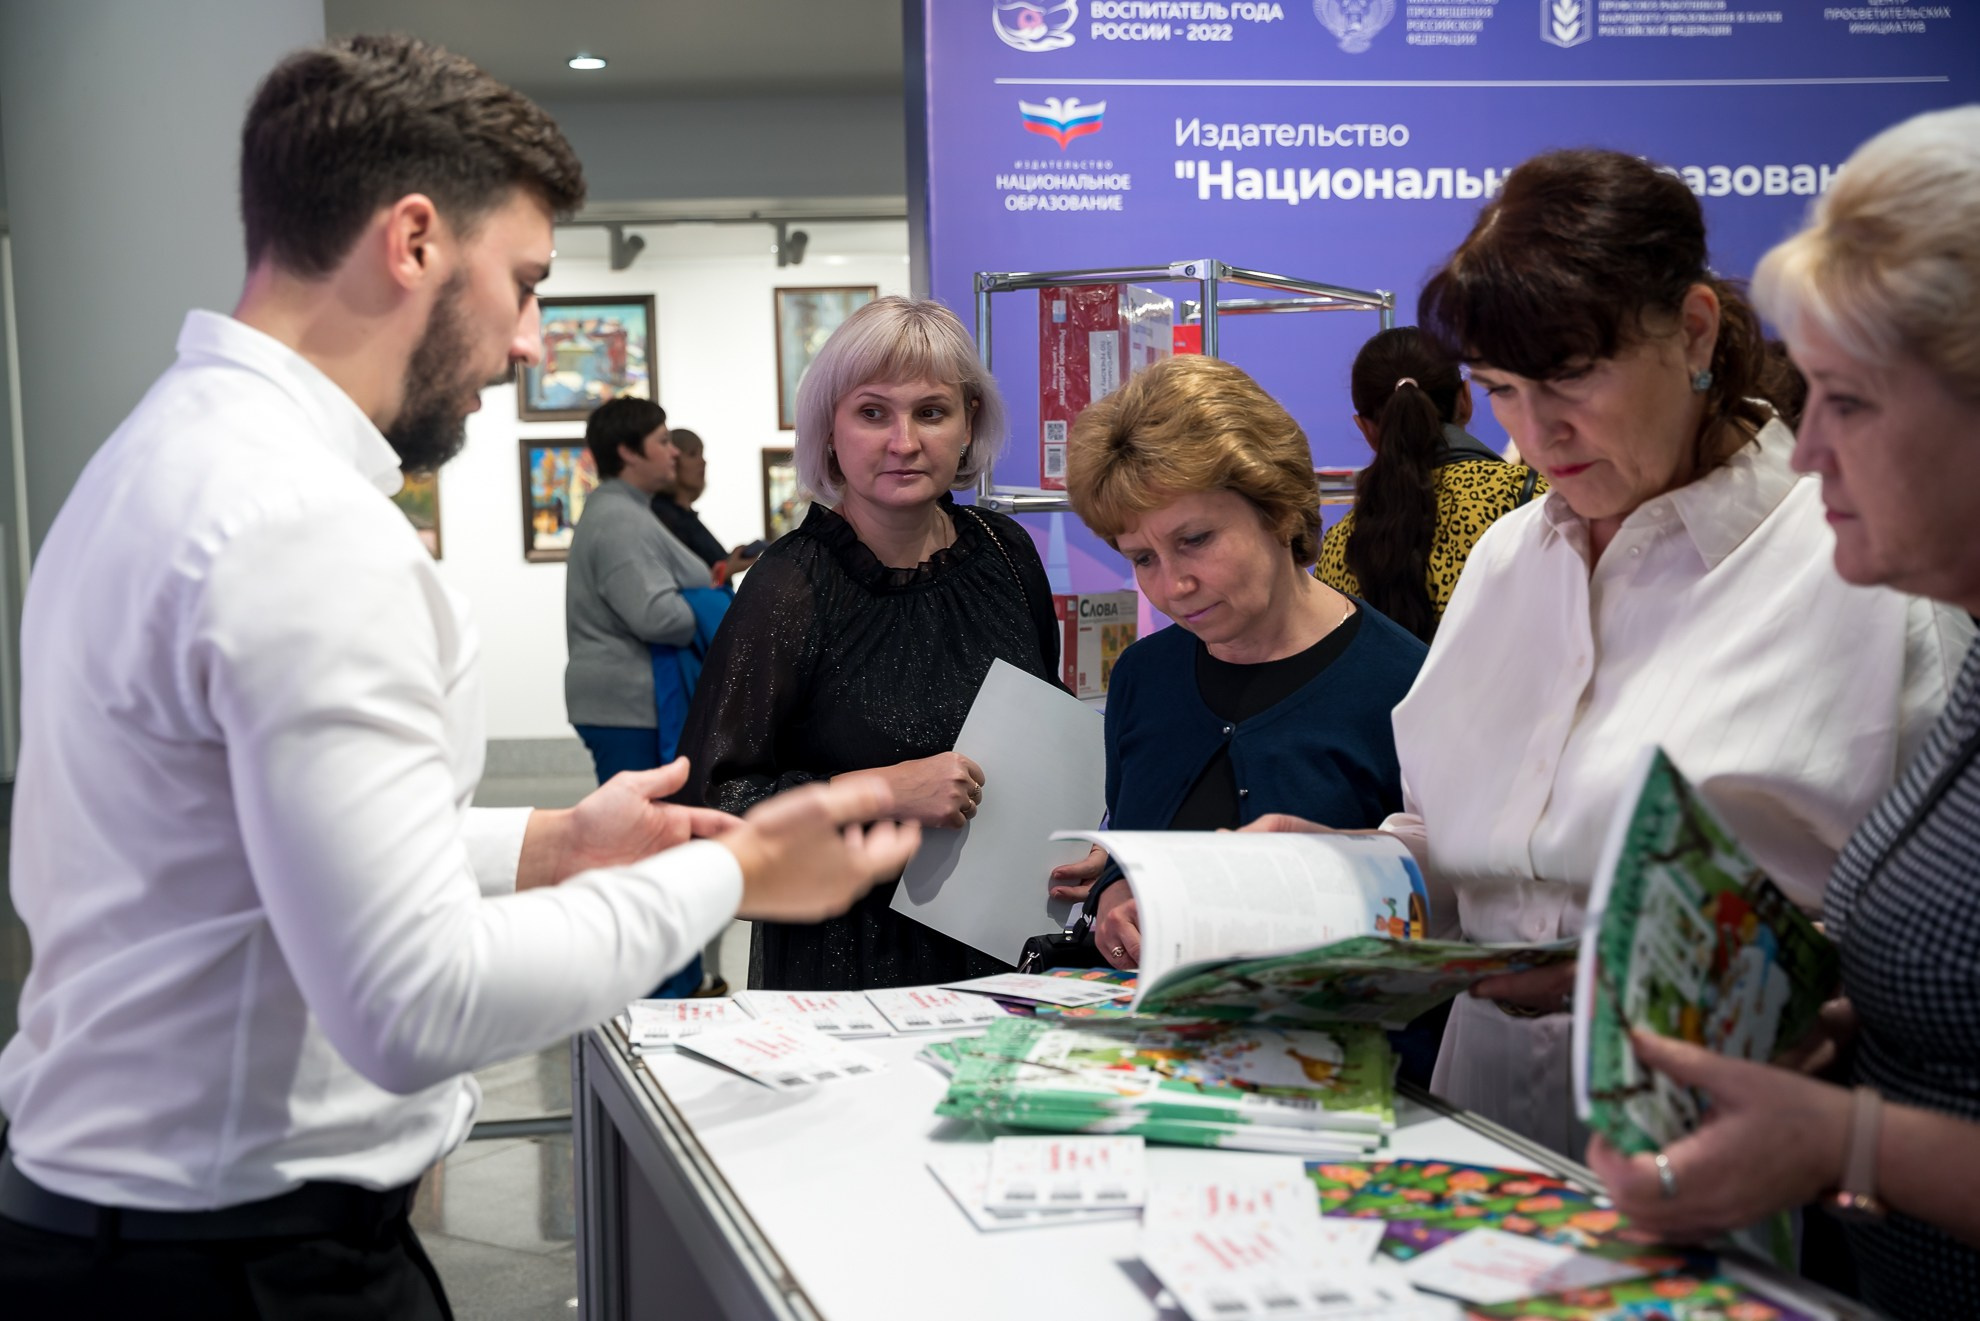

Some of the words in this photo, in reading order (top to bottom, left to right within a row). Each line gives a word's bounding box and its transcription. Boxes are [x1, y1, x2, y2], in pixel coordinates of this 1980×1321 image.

[1090, 1, 1229, 20] ВОСПИТАТЕЛЬ
[1231, 2, 1285, 23] ГОДА
[1823, 6, 1952, 20] ПРОСВЕТИТЕЛЬСКИХ
[1090, 22, 1172, 41] РОССИИ
[1186, 23, 1234, 42] 2022
[1848, 20, 1926, 34] ИНИЦИАТИВ
[1175, 117, 1410, 151] Издательство
[996, 173, 1132, 192] НАЦИОНАЛЬНОЕ
[1174, 160, 1512, 206] "Национальн
[1004, 194, 1124, 211] ОБРАЗОВАНИЕ
